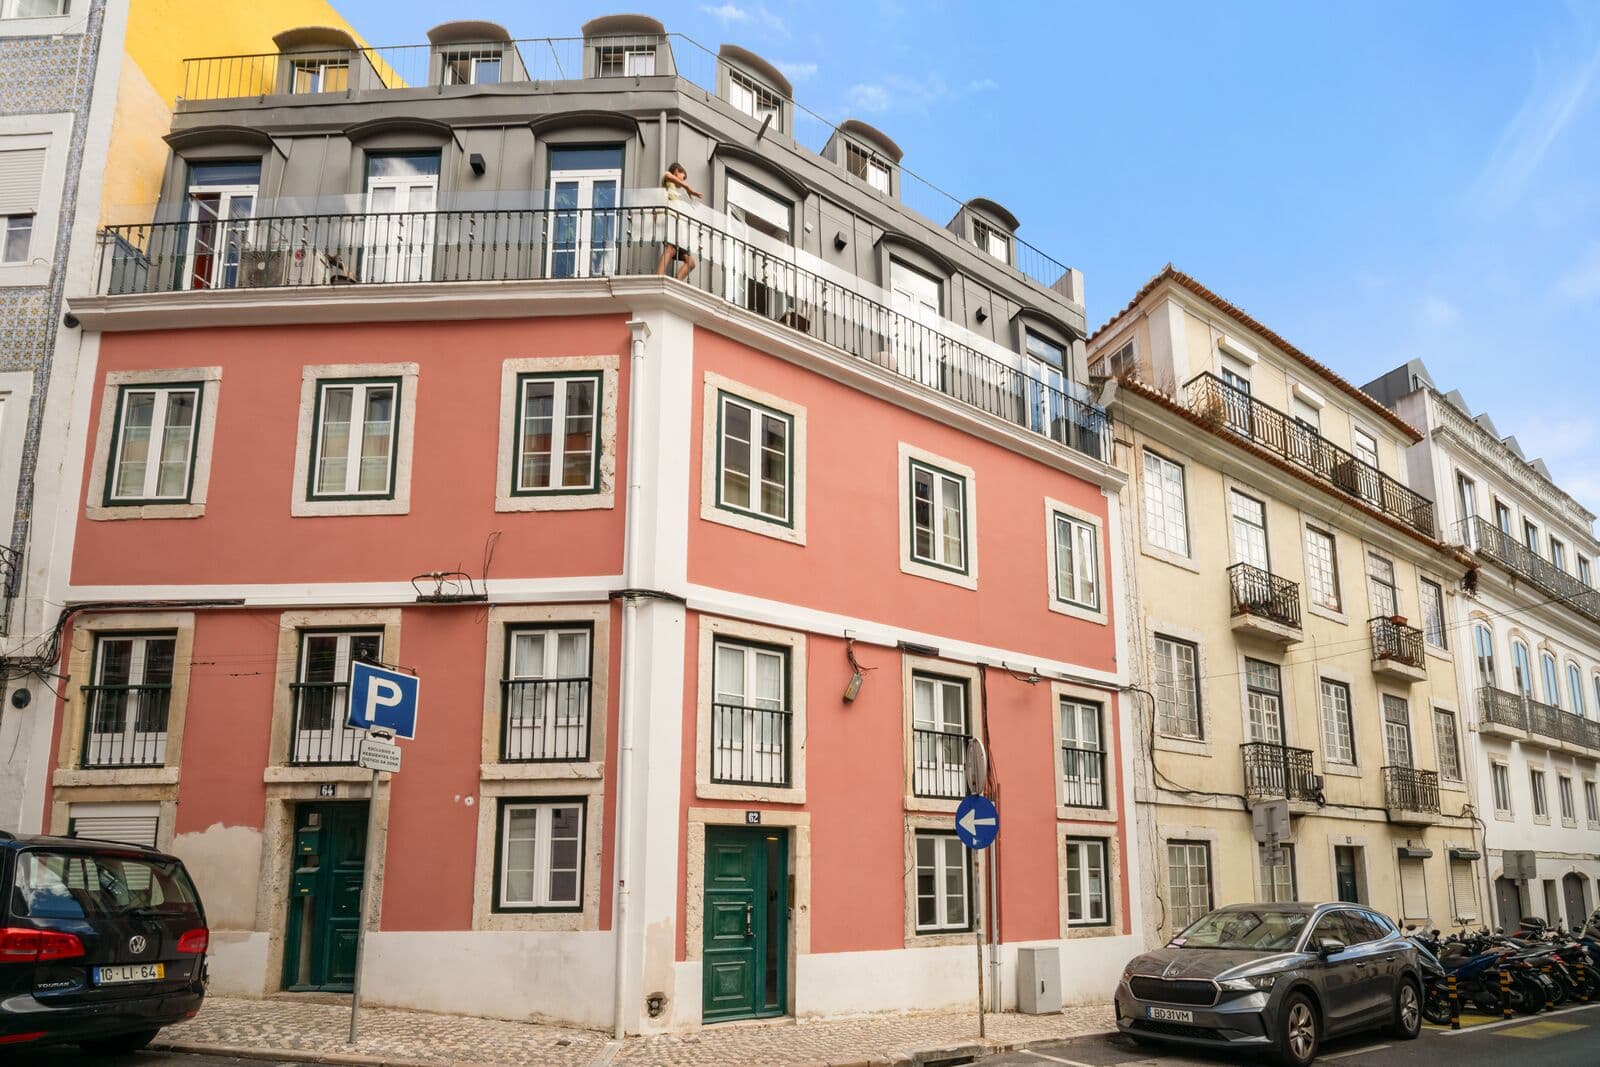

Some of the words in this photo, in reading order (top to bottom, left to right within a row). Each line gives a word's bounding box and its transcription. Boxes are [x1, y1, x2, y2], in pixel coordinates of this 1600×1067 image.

[364, 675, 403, 722] P
[321, 785, 334, 796] 64
[748, 812, 759, 823] 62
[37, 981, 70, 989] TOURAN
